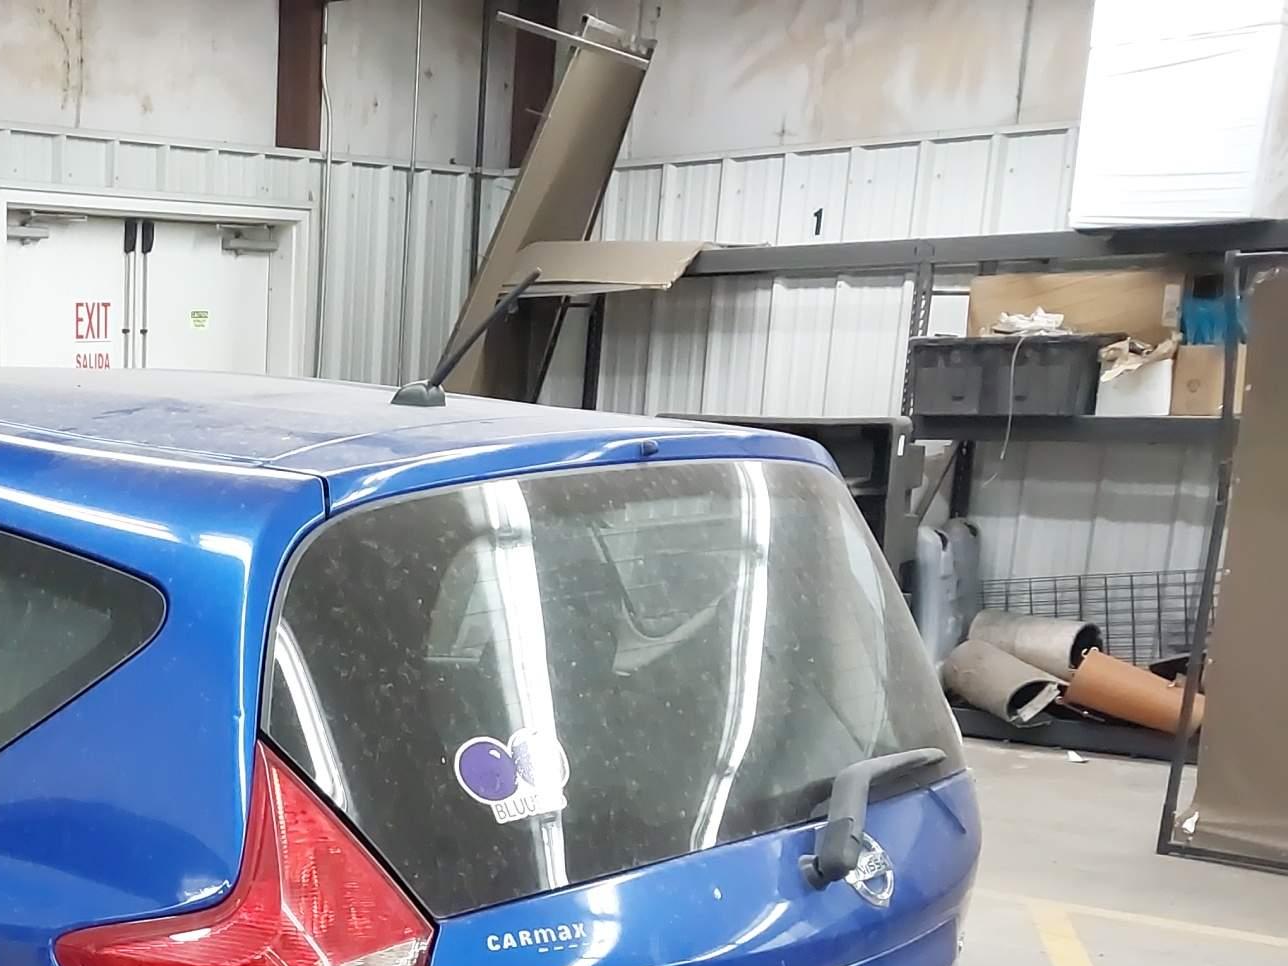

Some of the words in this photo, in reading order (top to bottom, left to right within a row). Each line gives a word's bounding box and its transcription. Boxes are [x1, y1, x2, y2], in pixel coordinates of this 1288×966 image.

[814, 208, 823, 236] 1
[75, 303, 111, 339] EXIT
[75, 353, 110, 369] SALIDA
